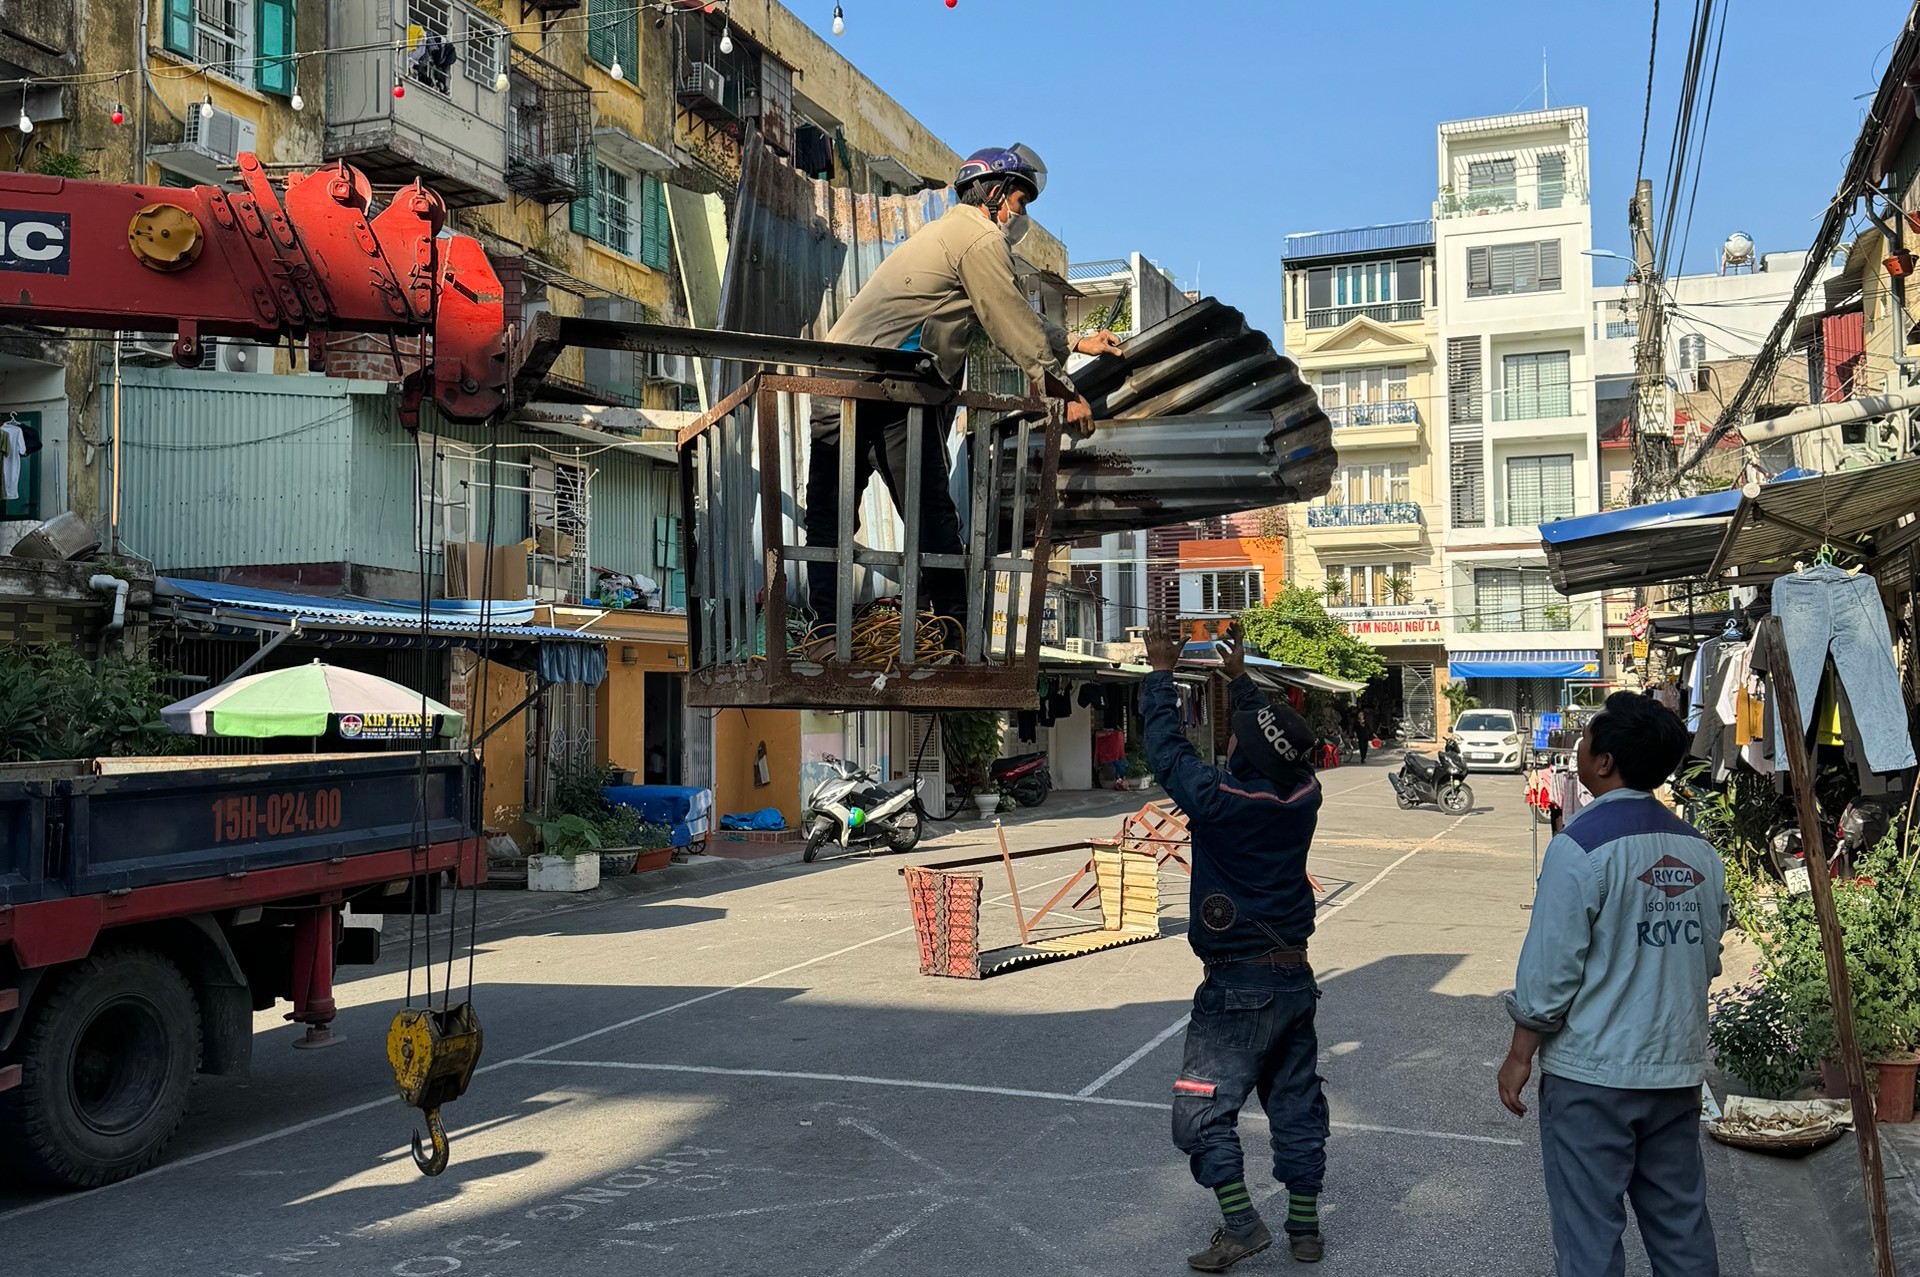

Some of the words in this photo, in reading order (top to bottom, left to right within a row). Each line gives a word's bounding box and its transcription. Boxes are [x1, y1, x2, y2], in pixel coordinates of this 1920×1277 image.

[1374, 621, 1402, 635] NGOẠI
[363, 713, 387, 727] KIM
[390, 713, 433, 727] THANH
[1257, 705, 1298, 761] didas
[211, 788, 342, 843] 15H-024.00
